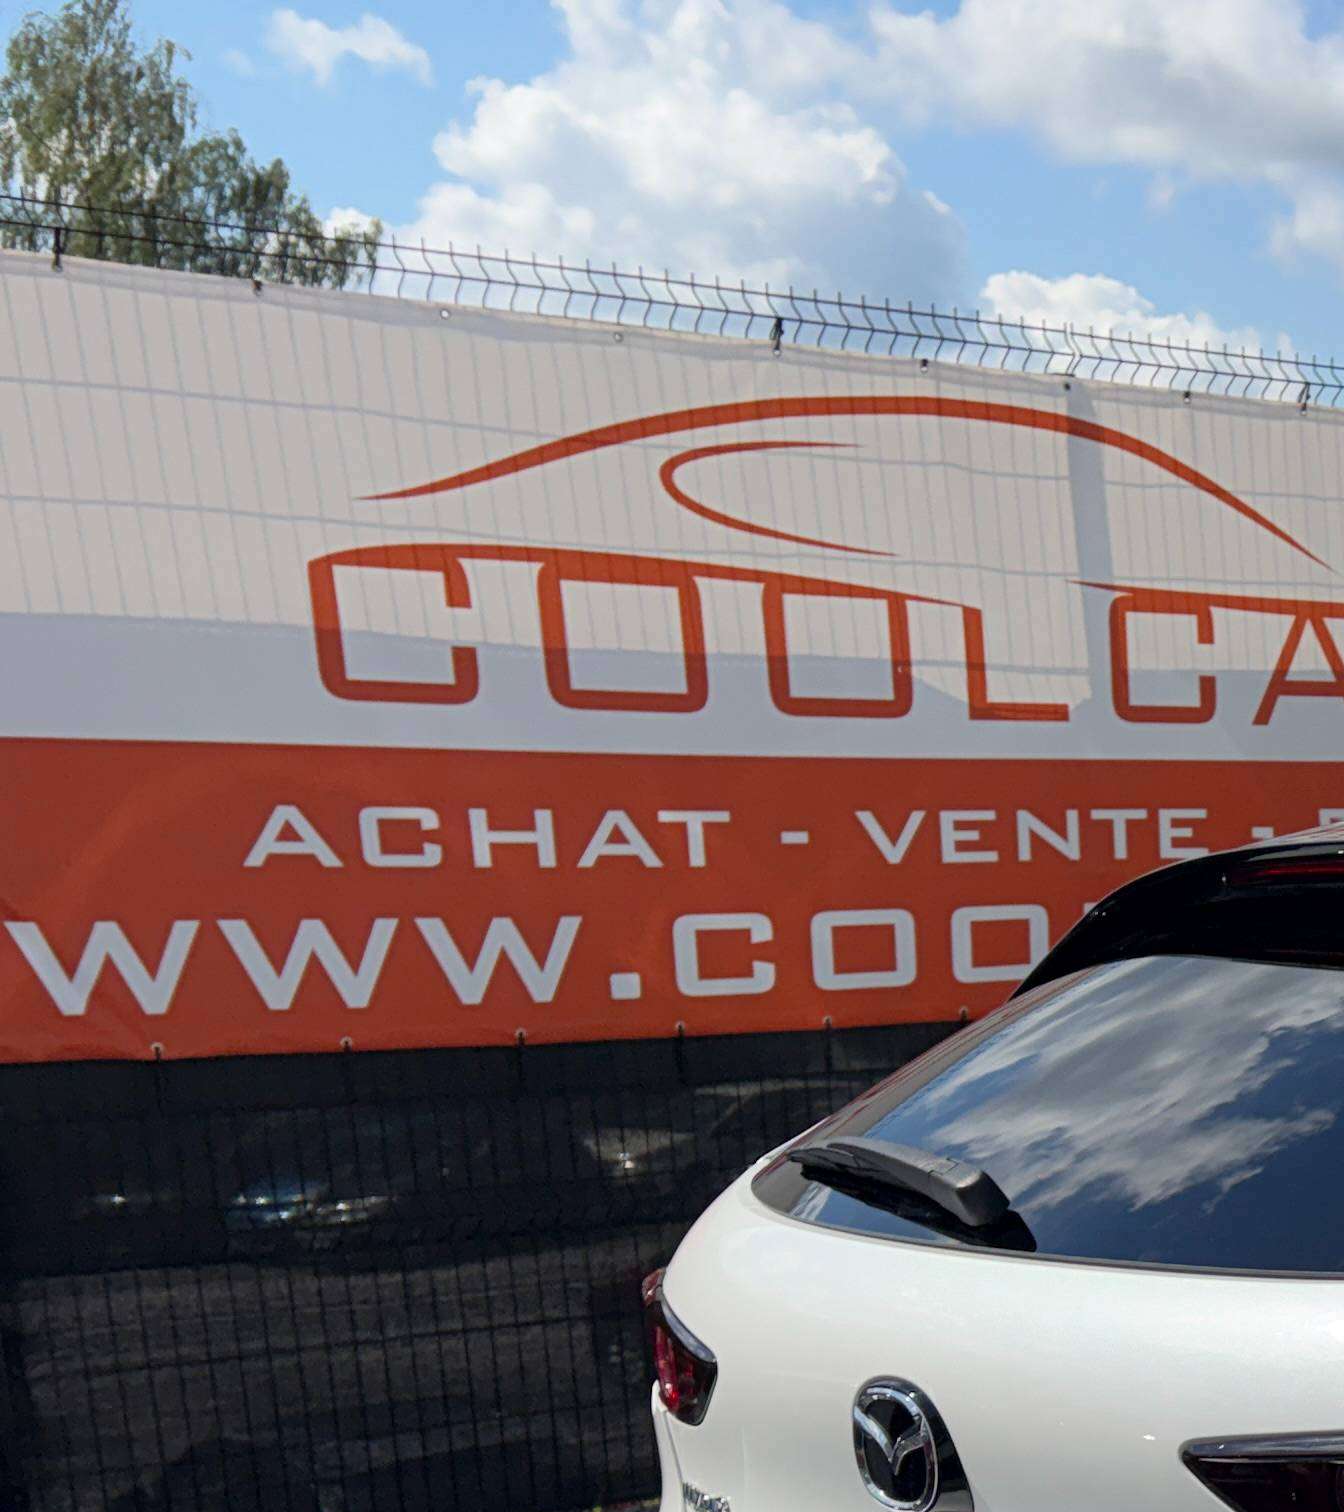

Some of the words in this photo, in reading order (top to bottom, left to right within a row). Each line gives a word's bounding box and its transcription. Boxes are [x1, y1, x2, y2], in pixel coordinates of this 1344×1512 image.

[243, 804, 730, 868] ACHAT
[856, 808, 1208, 868] VENTE
[5, 904, 1098, 1017] WWW.COO
